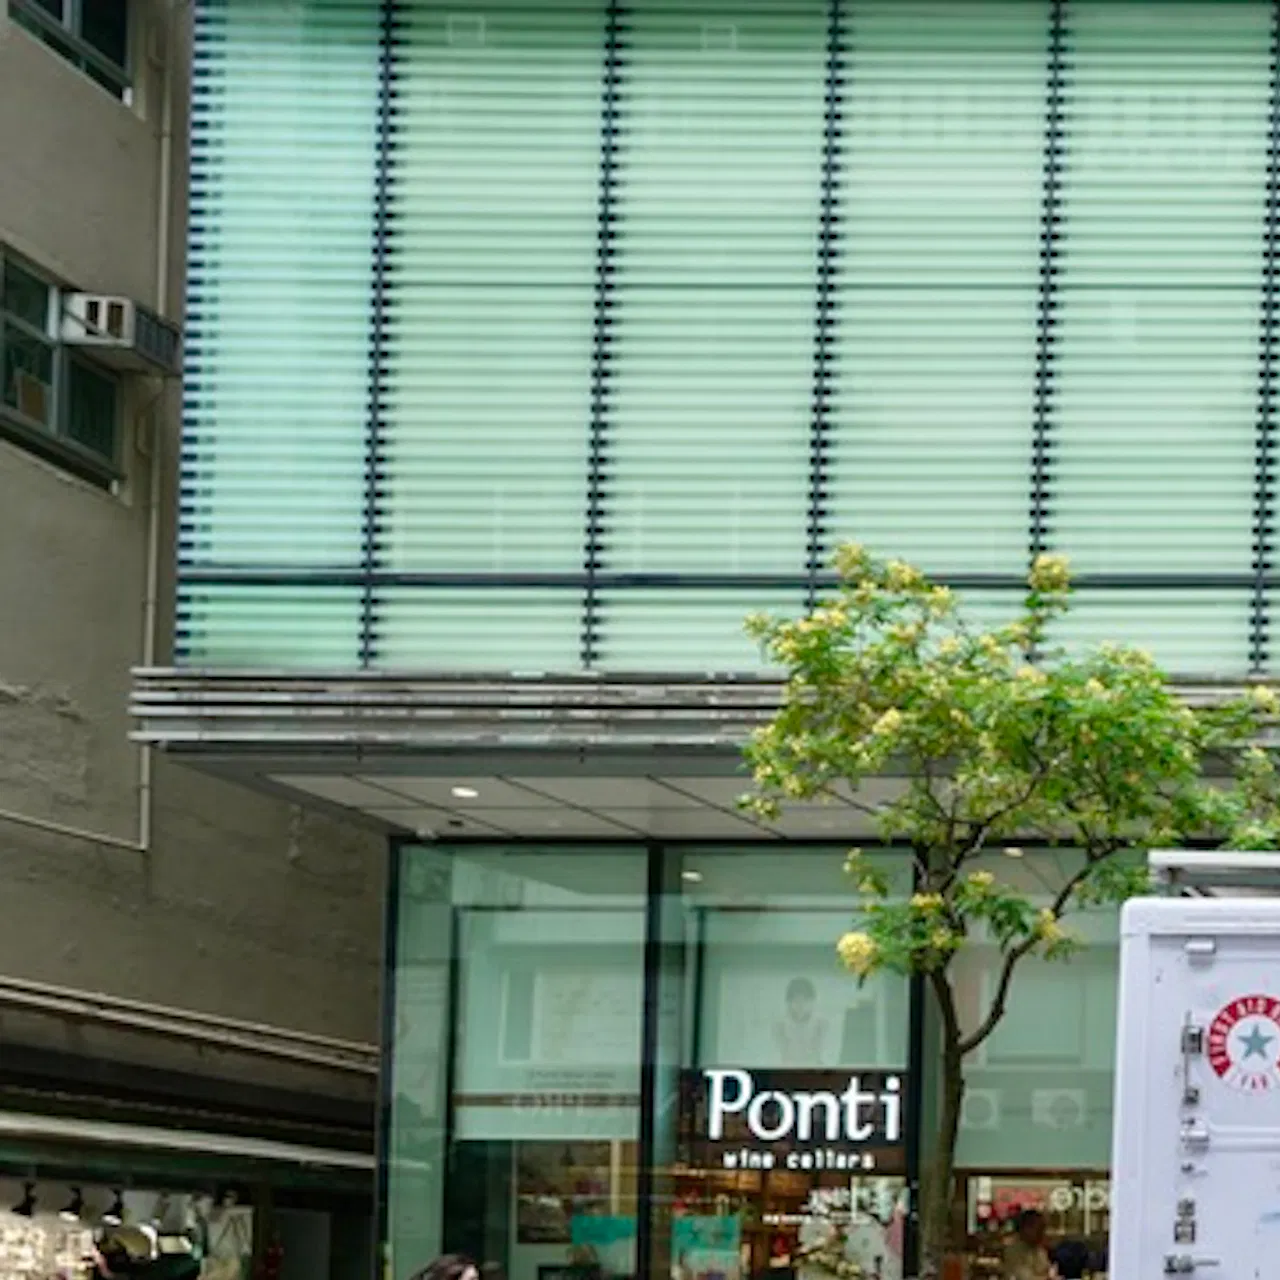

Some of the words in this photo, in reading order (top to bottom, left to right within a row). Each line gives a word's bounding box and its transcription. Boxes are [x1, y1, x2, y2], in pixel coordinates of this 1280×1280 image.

[703, 1069, 901, 1141] Ponti
[722, 1148, 774, 1169] wine
[786, 1149, 876, 1169] cellars
